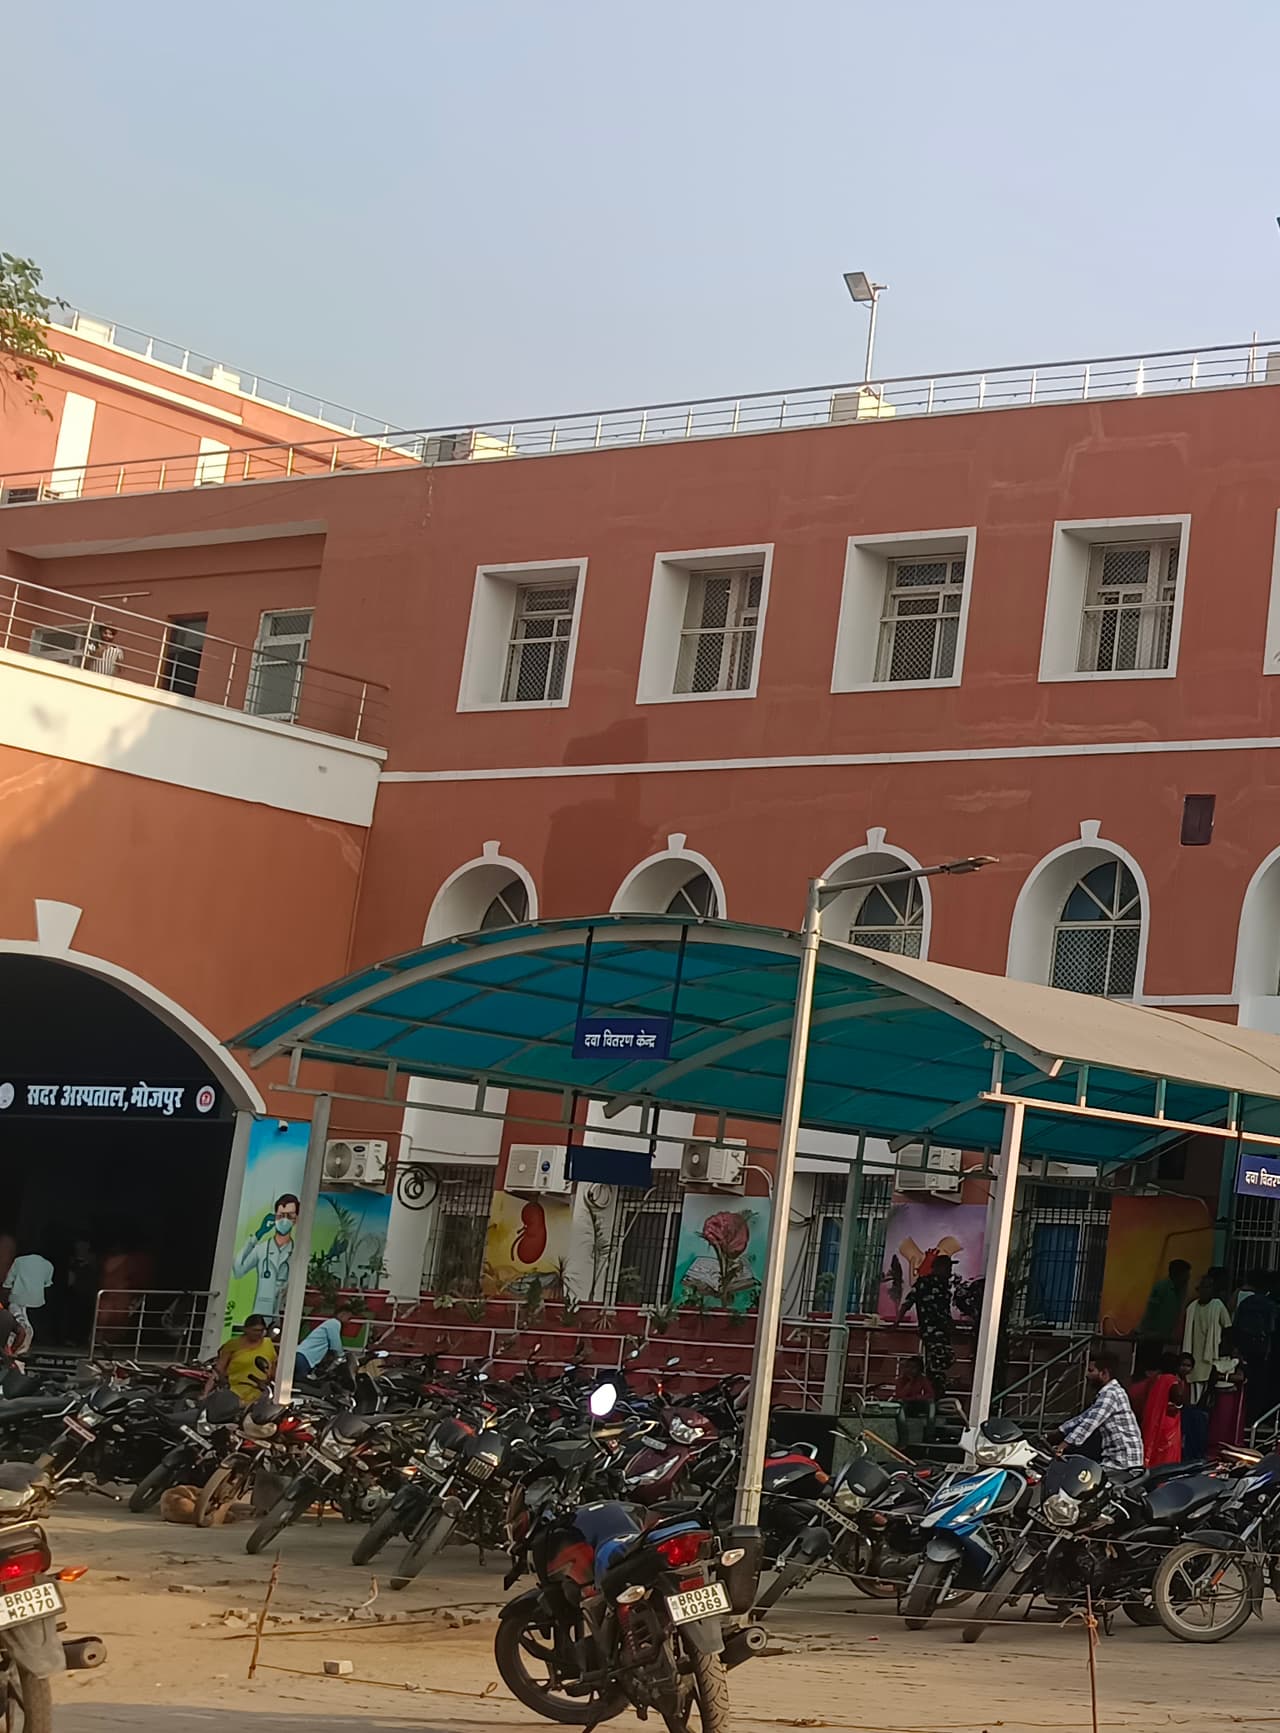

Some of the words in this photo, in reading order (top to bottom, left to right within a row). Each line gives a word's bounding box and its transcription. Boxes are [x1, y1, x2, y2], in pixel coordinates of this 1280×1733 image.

[584, 1033, 601, 1048] दवा
[602, 1028, 635, 1048] वितरण
[26, 1084, 60, 1107] सदर
[4, 1586, 52, 1608] BR03A
[677, 1585, 718, 1606] BR03A
[681, 1597, 722, 1617] K0369
